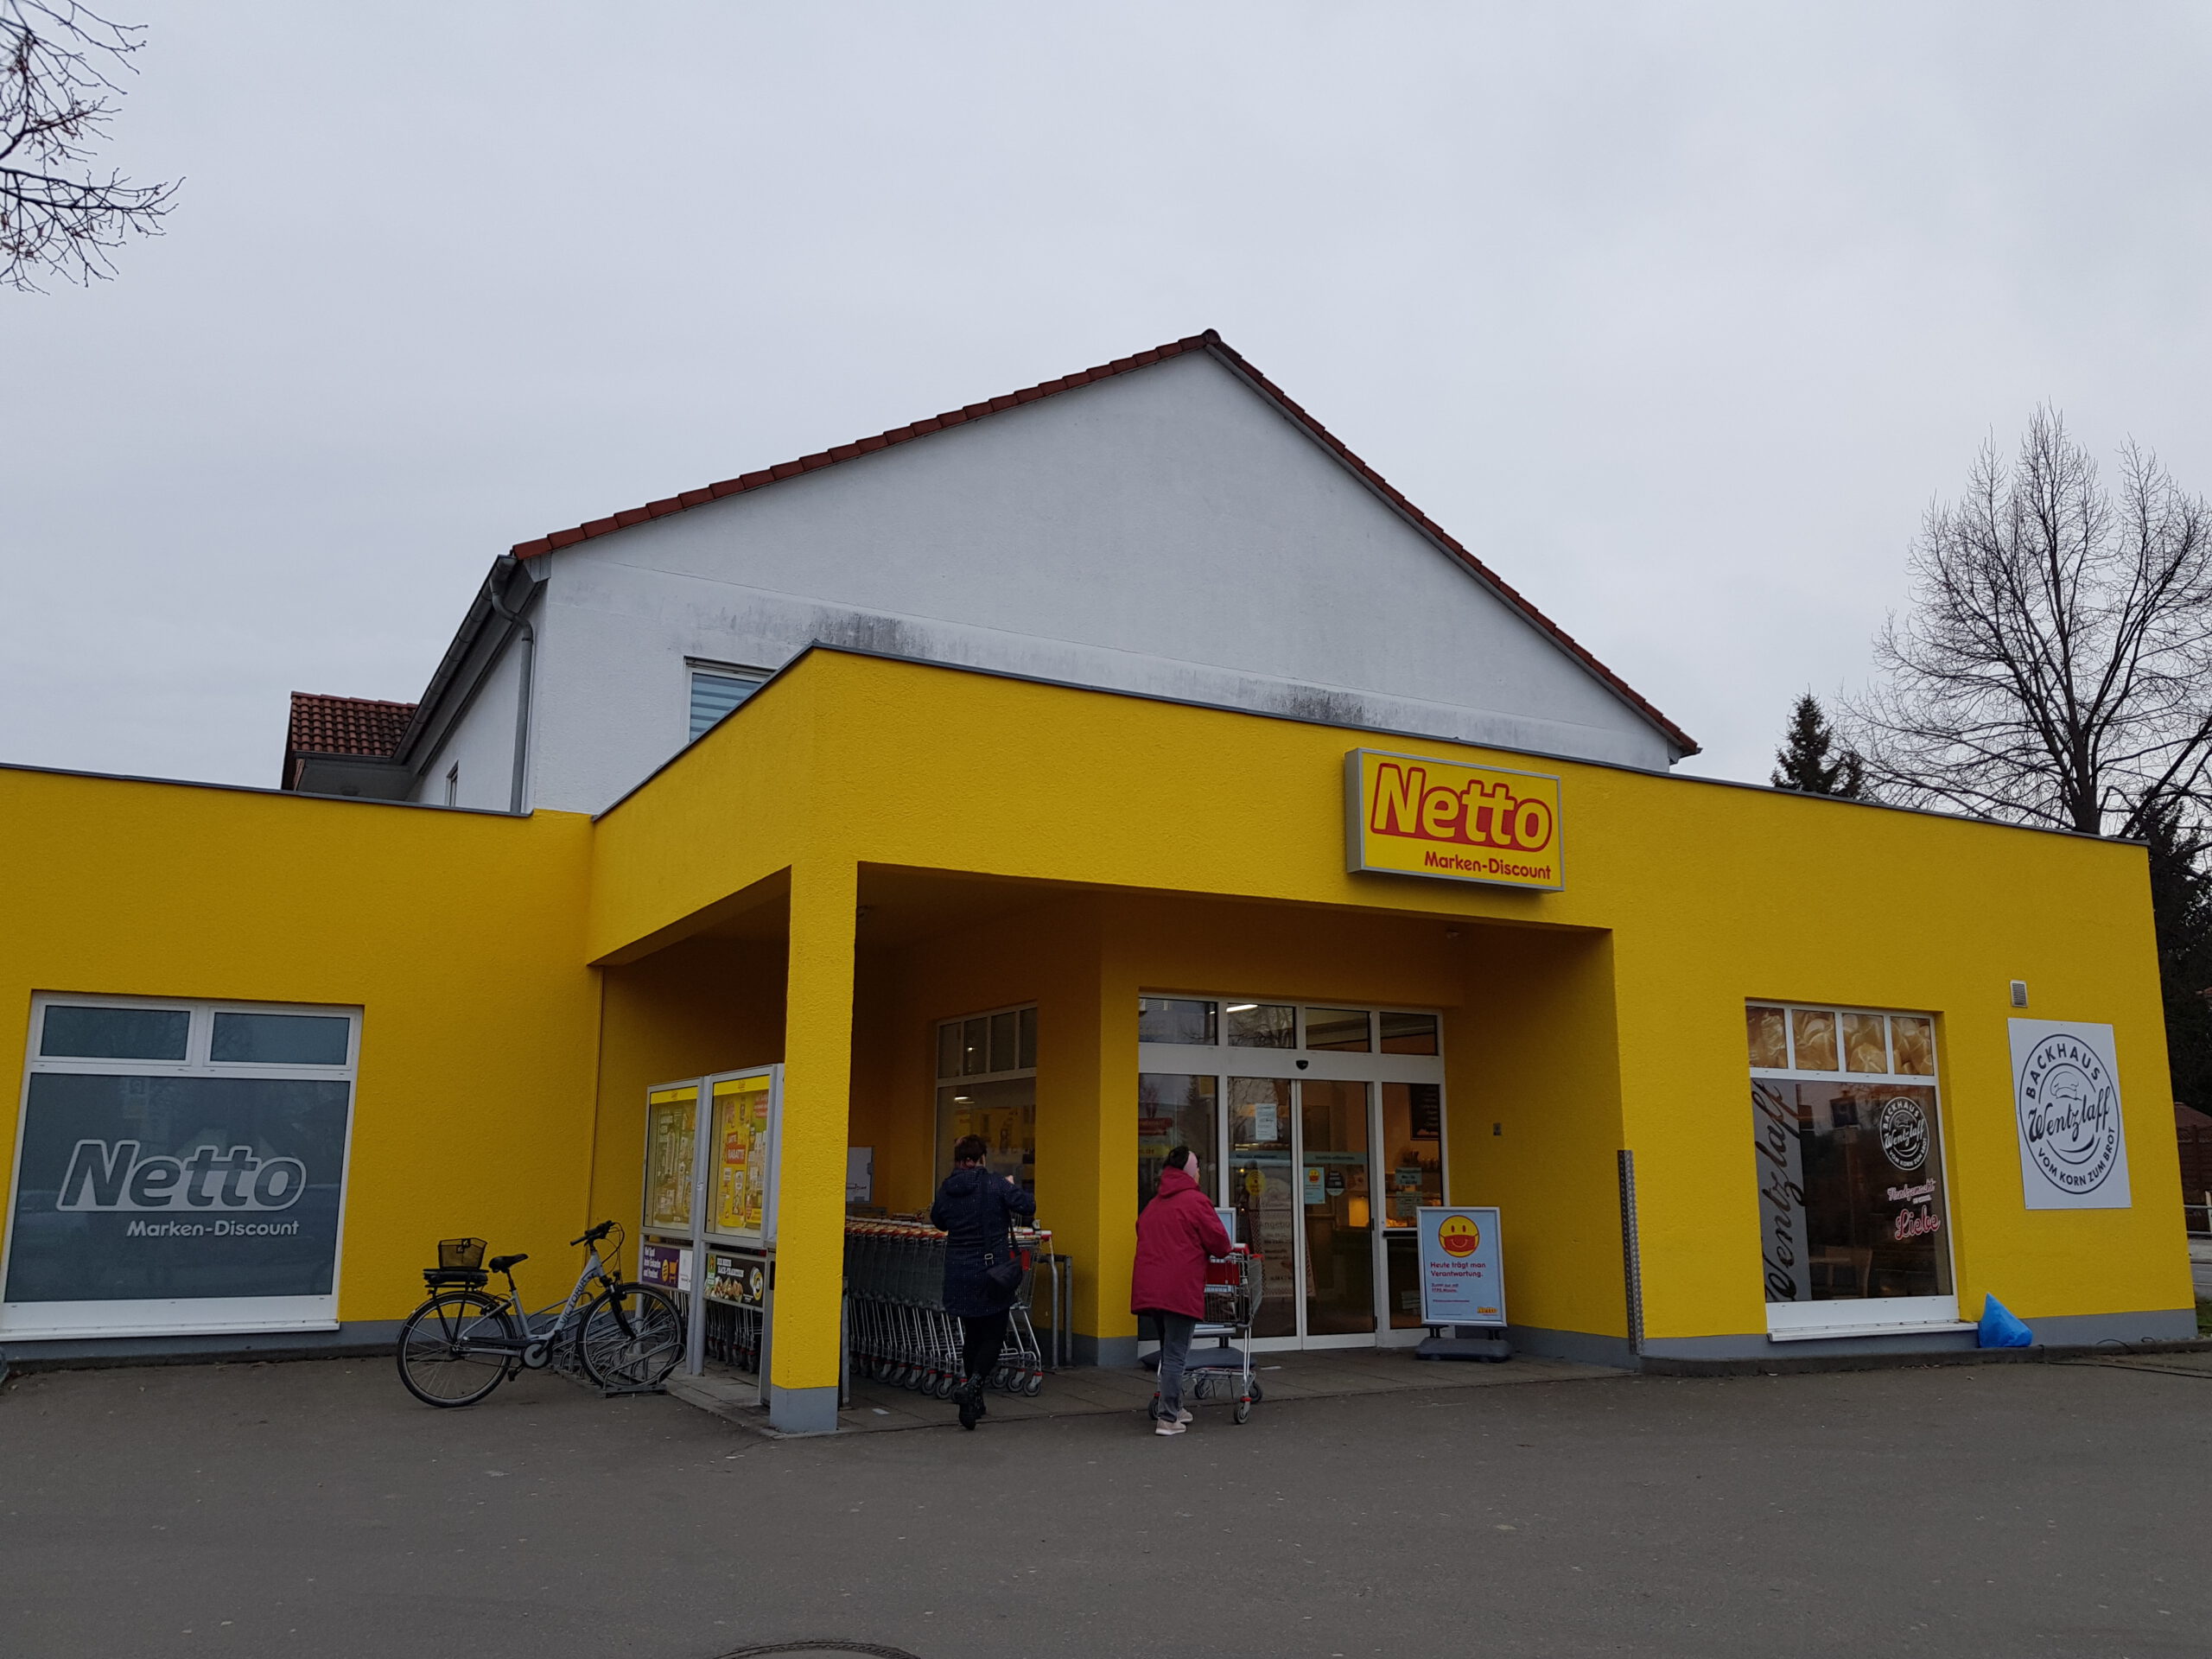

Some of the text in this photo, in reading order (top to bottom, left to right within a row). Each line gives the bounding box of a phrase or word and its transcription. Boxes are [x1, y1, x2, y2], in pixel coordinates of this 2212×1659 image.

[1370, 763, 1553, 852] Netto
[1424, 851, 1552, 880] Marken-Discount
[2026, 1043, 2101, 1099] BACKHAUS
[1882, 1100, 1920, 1129] BACKHAUS
[1884, 1118, 1926, 1149] Wentzlaff
[2028, 1085, 2111, 1143] Wentzlaff
[56, 1140, 307, 1211] Netto
[2037, 1126, 2116, 1186] VOM KORN ZUM BROT
[126, 1219, 300, 1237] Marken-Discount
[1895, 1205, 1941, 1240] Liebe
[560, 1279, 588, 1325] VICTORIA
